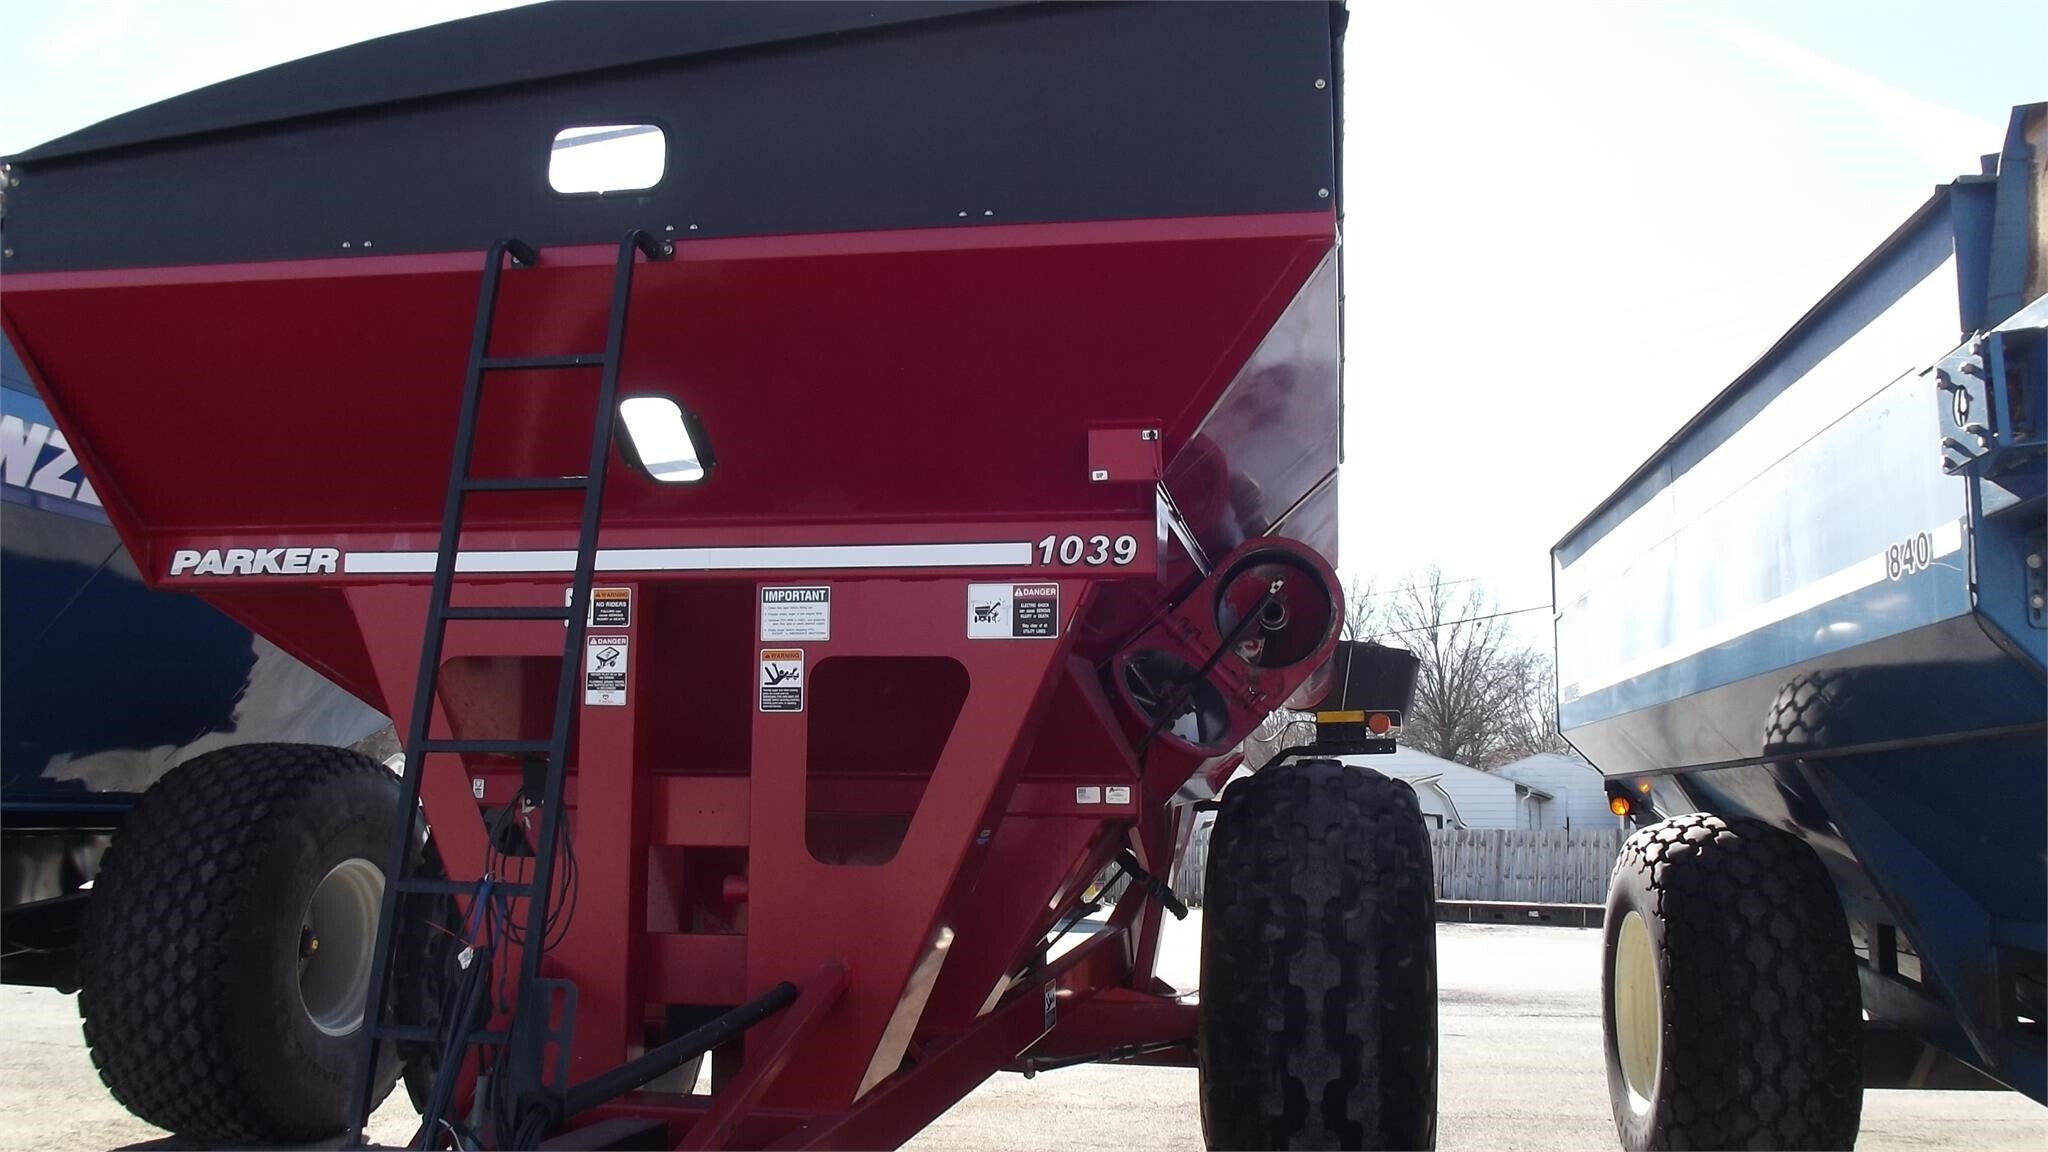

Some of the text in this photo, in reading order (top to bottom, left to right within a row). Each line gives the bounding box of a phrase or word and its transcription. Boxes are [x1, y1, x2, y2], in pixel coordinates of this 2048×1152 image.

[169, 547, 340, 576] PARKER
[1038, 534, 1138, 566] 1039
[1887, 531, 1931, 580] 840
[765, 590, 826, 601] IMPORTANT
[1023, 587, 1056, 596] DANGER
